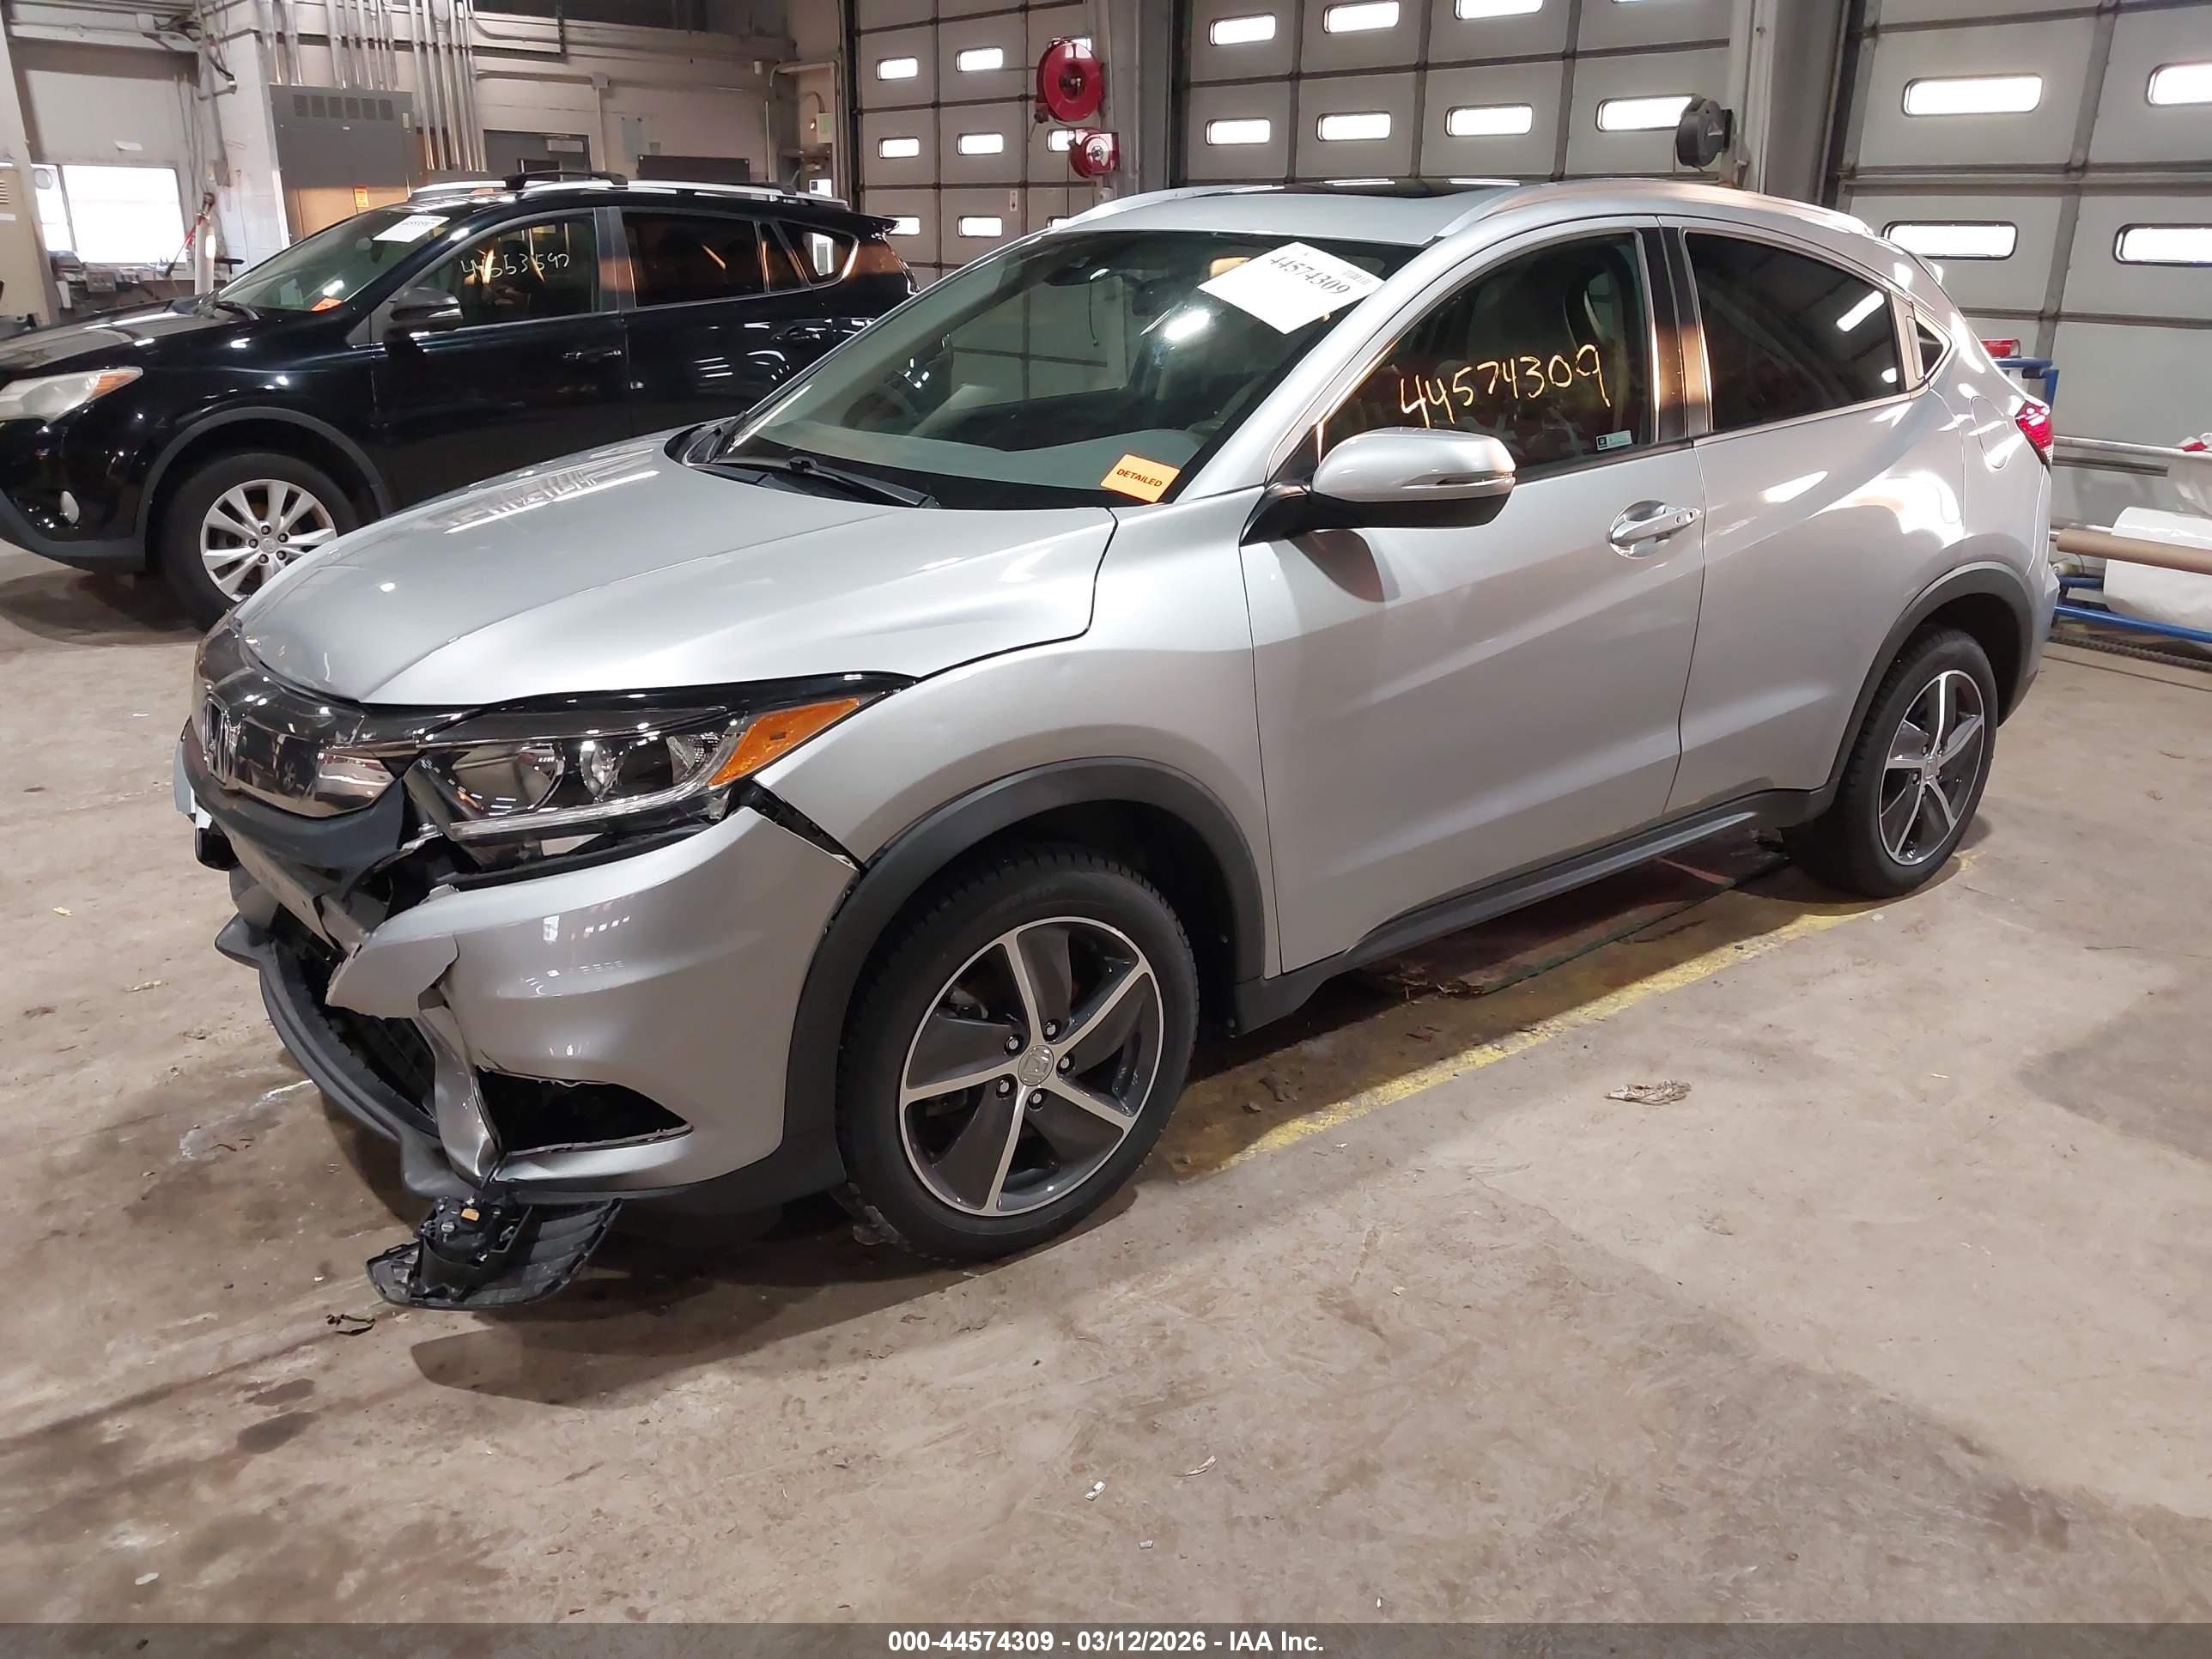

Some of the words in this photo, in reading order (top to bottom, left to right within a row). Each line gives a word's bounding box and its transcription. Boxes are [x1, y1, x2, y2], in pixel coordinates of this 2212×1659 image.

[1270, 257, 1351, 294] 44574309
[1401, 343, 1611, 429] 44574309
[1116, 468, 1163, 487] DETAILED
